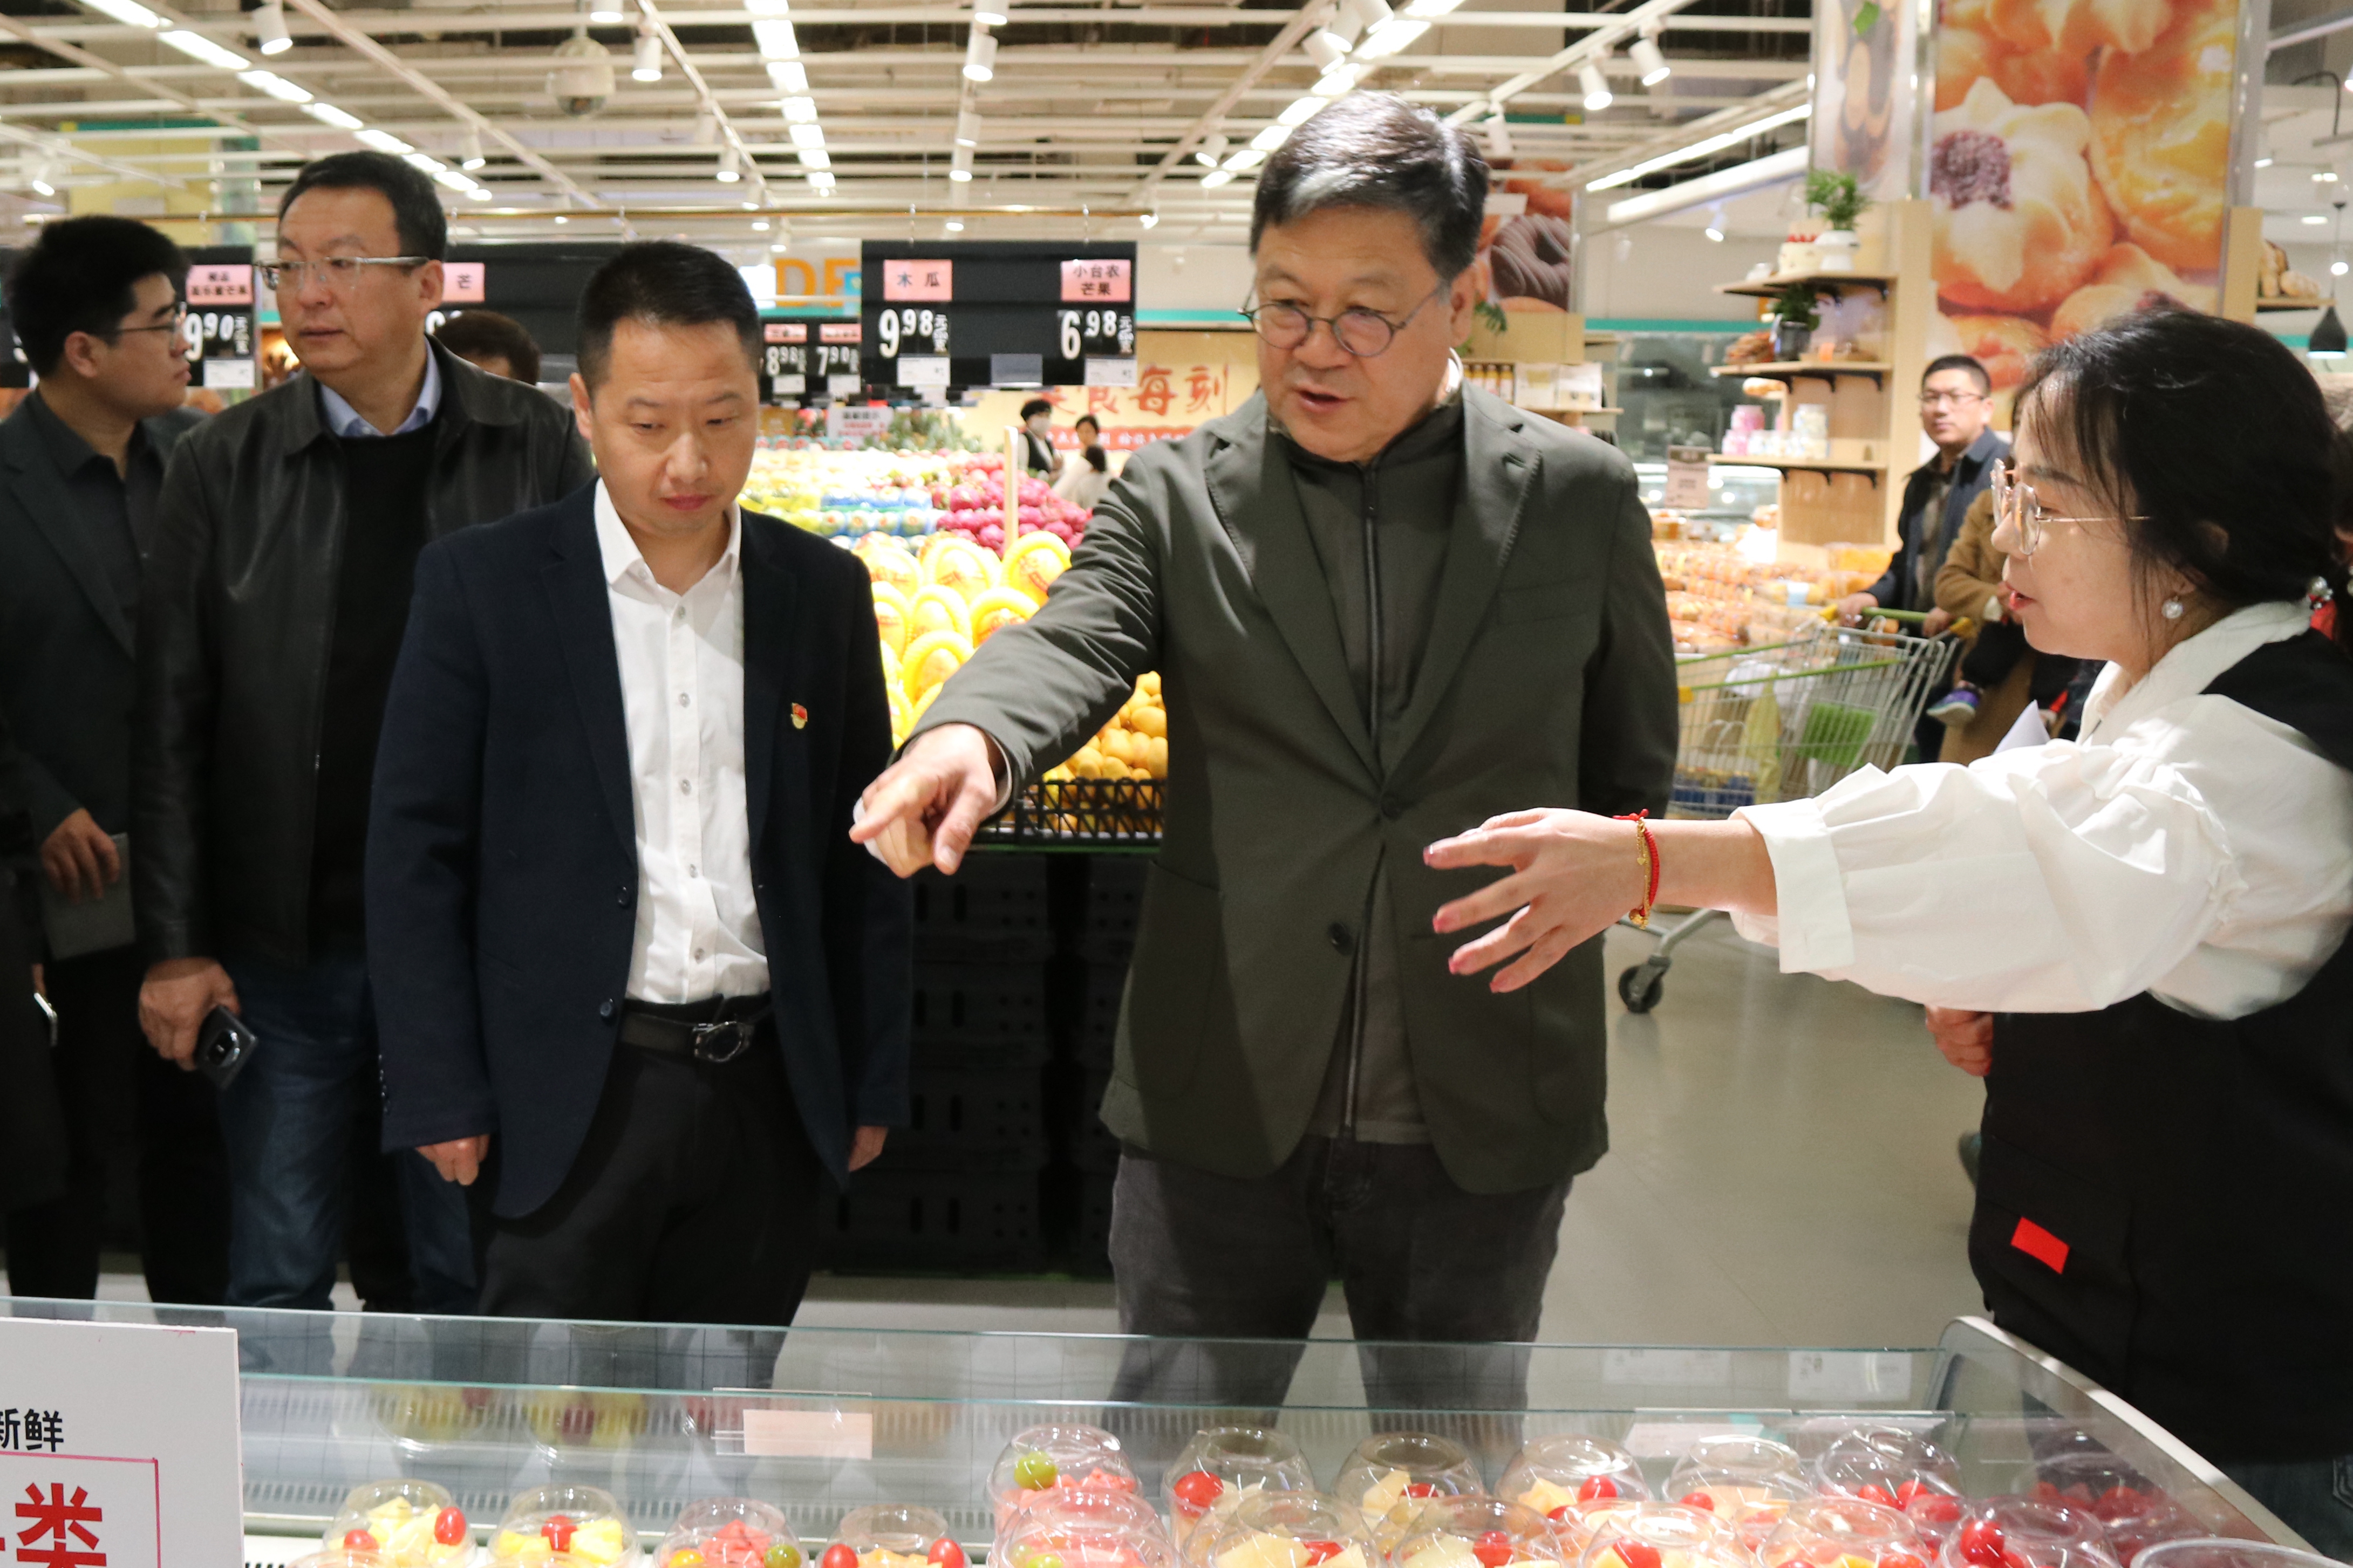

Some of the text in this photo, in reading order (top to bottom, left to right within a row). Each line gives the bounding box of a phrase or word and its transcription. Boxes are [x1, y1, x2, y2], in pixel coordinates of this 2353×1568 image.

[1074, 264, 1120, 278] 小台农
[897, 272, 939, 287] 木瓜
[1081, 282, 1111, 296] 芒果
[0, 1482, 107, 1568] 类
